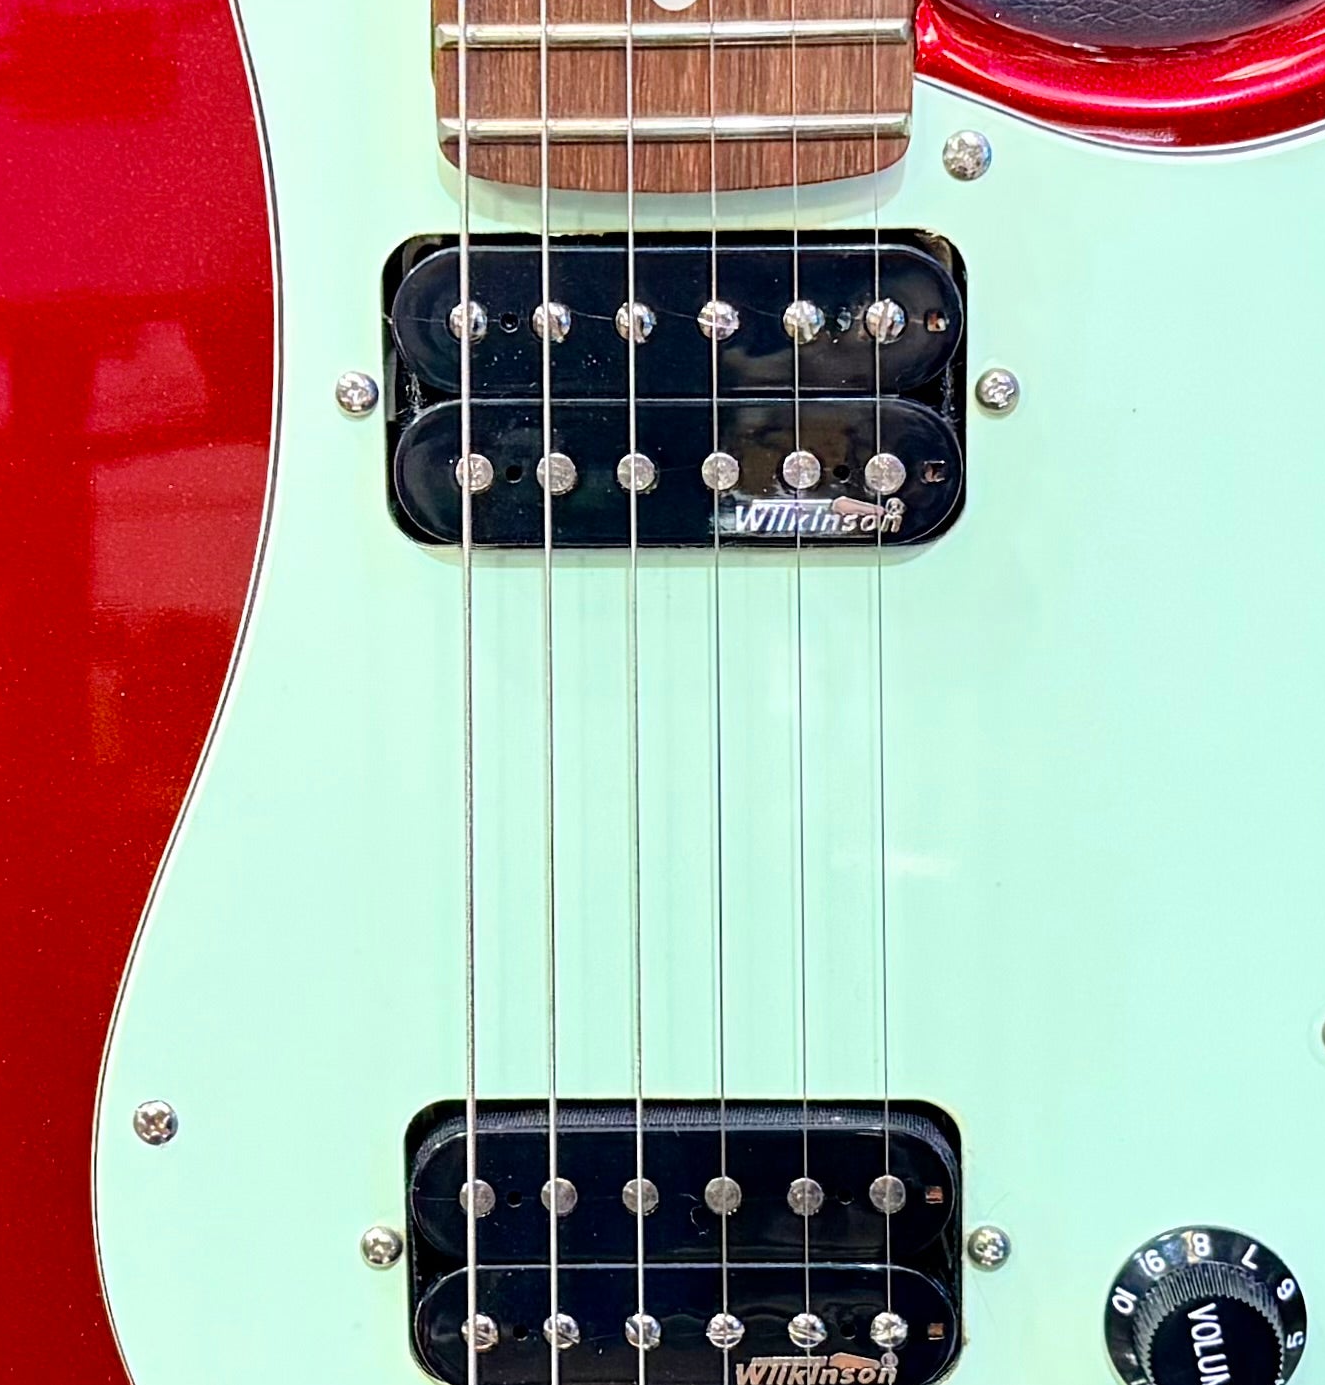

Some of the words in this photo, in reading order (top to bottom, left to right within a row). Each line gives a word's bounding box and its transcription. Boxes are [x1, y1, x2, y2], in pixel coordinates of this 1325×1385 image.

[735, 500, 903, 533] Wilkinson
[1111, 1286, 1139, 1315] 10
[1192, 1232, 1211, 1257] 8
[1286, 1330, 1304, 1349] 5
